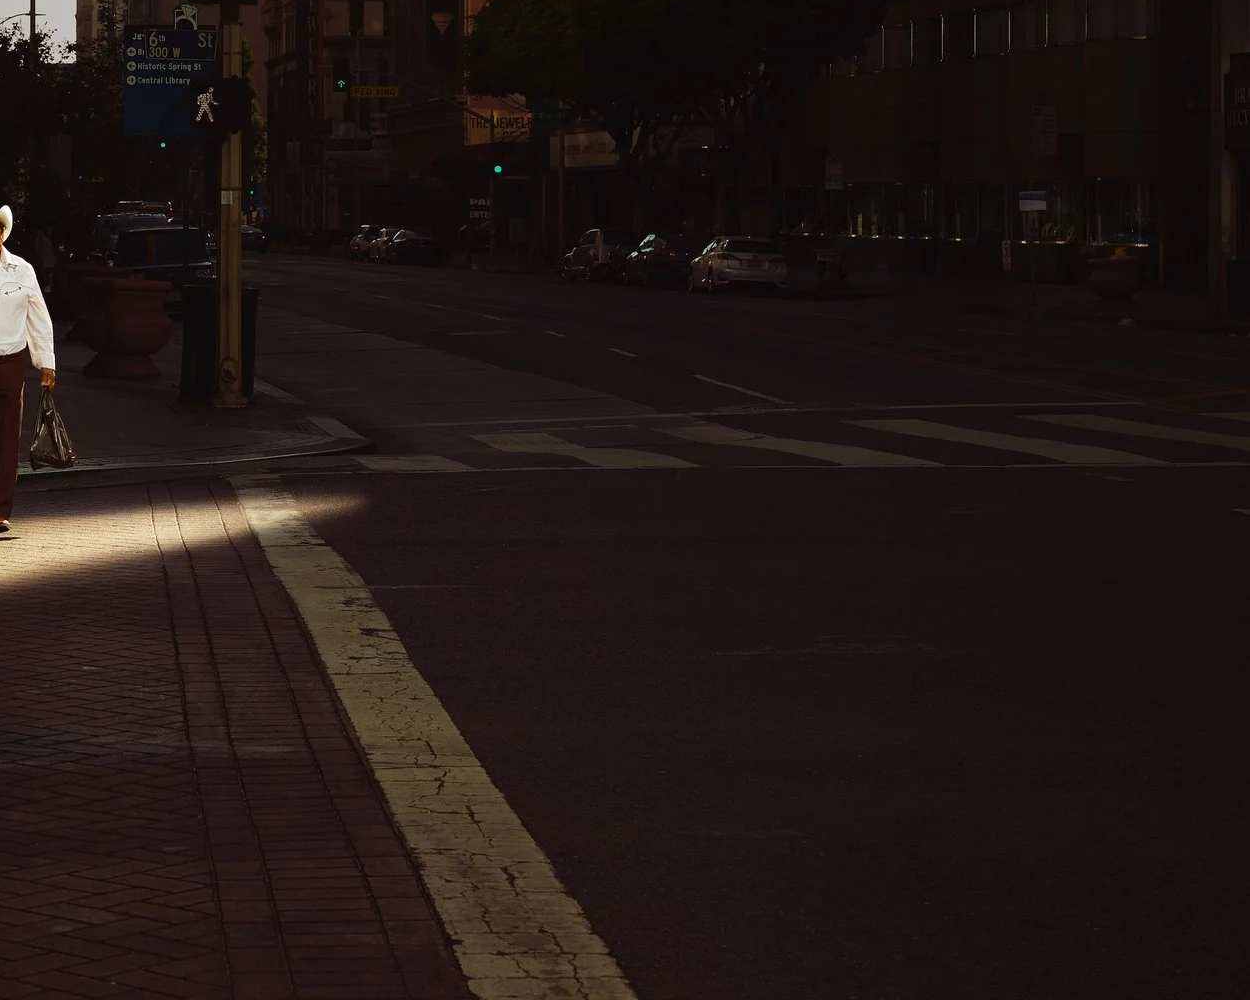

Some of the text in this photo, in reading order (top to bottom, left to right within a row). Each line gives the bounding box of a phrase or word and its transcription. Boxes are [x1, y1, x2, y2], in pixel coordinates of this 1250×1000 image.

[149, 31, 213, 48] 6th St
[149, 47, 181, 58] 300 W
[137, 62, 202, 72] Historic Spring St
[137, 76, 191, 86] Central Library
[354, 87, 396, 96] PED XING
